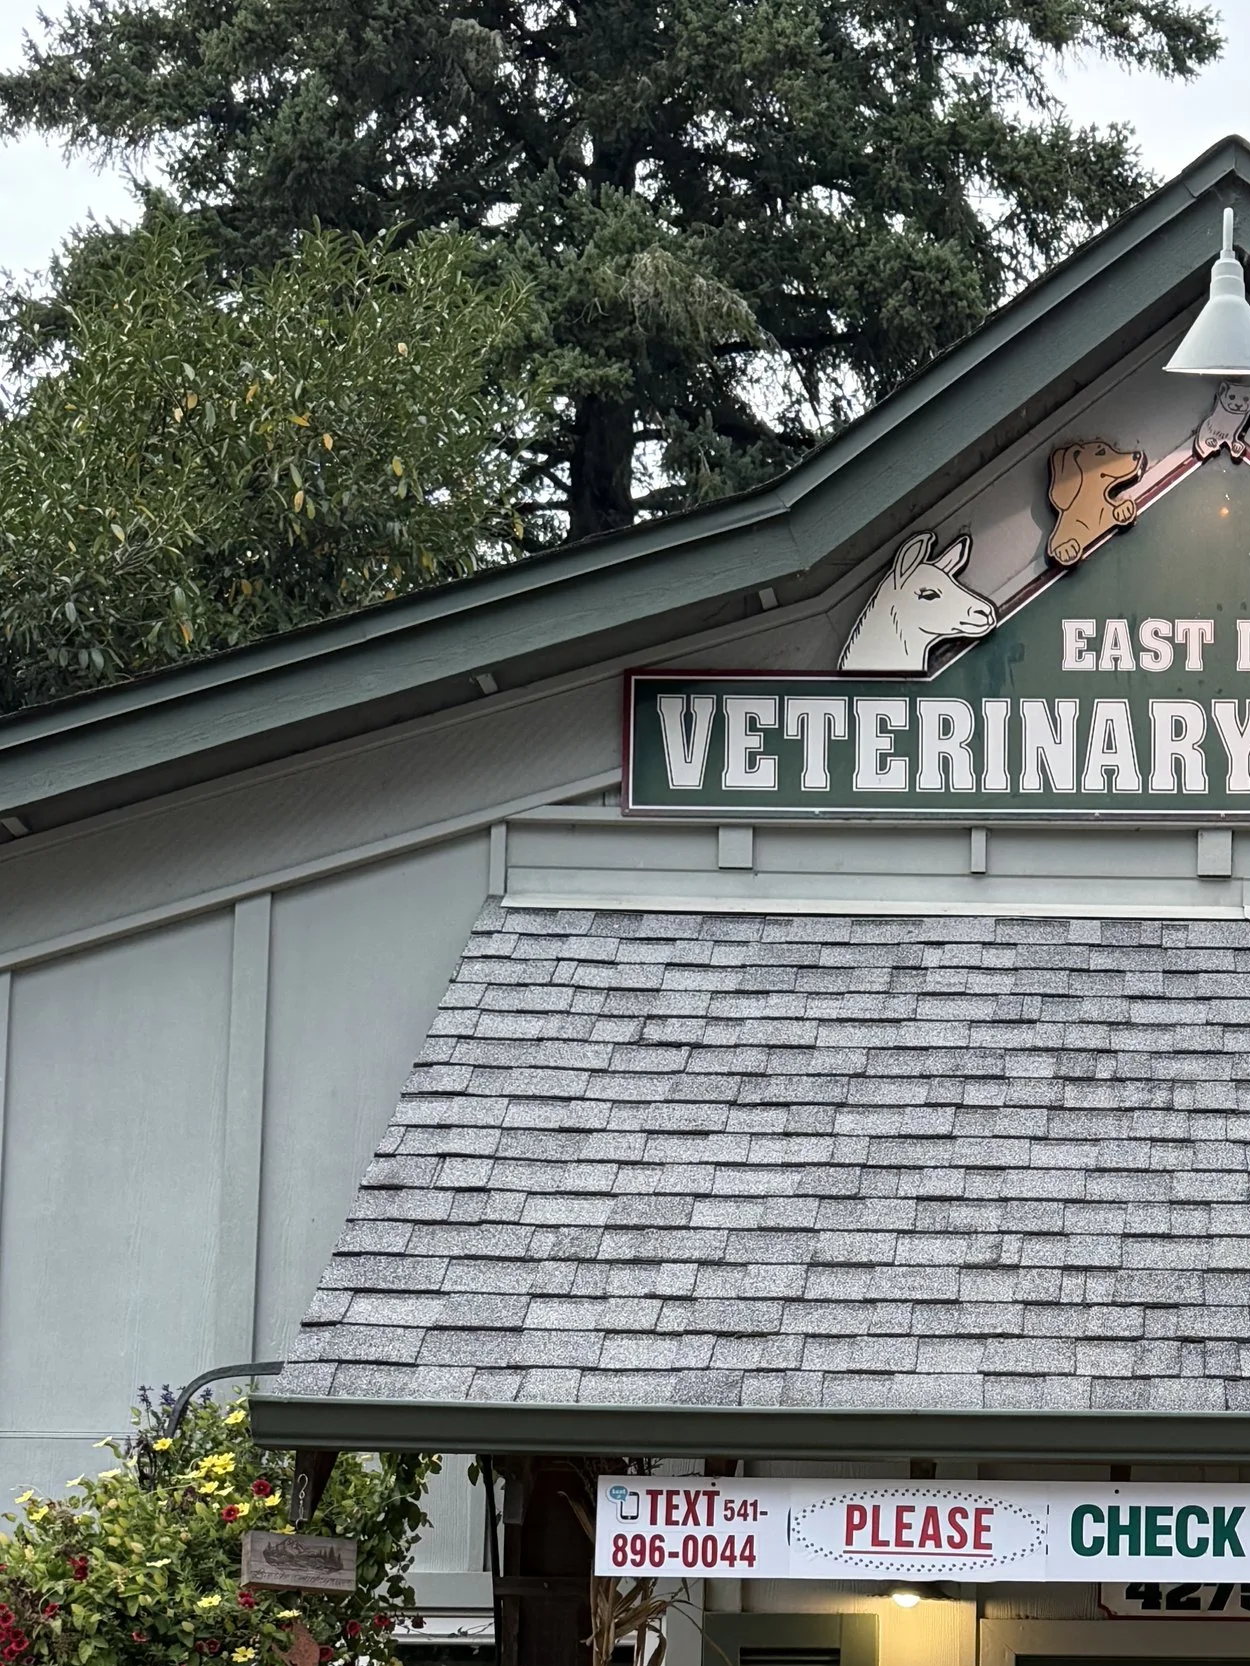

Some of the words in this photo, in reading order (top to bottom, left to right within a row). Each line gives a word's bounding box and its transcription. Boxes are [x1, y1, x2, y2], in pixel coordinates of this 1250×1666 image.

[1061, 619, 1216, 672] EAST
[646, 1489, 720, 1526] TEXT
[723, 1500, 768, 1523] 541-
[843, 1505, 995, 1551] PLEASE
[1070, 1503, 1247, 1557] CHECK
[611, 1534, 757, 1568] 896-0044
